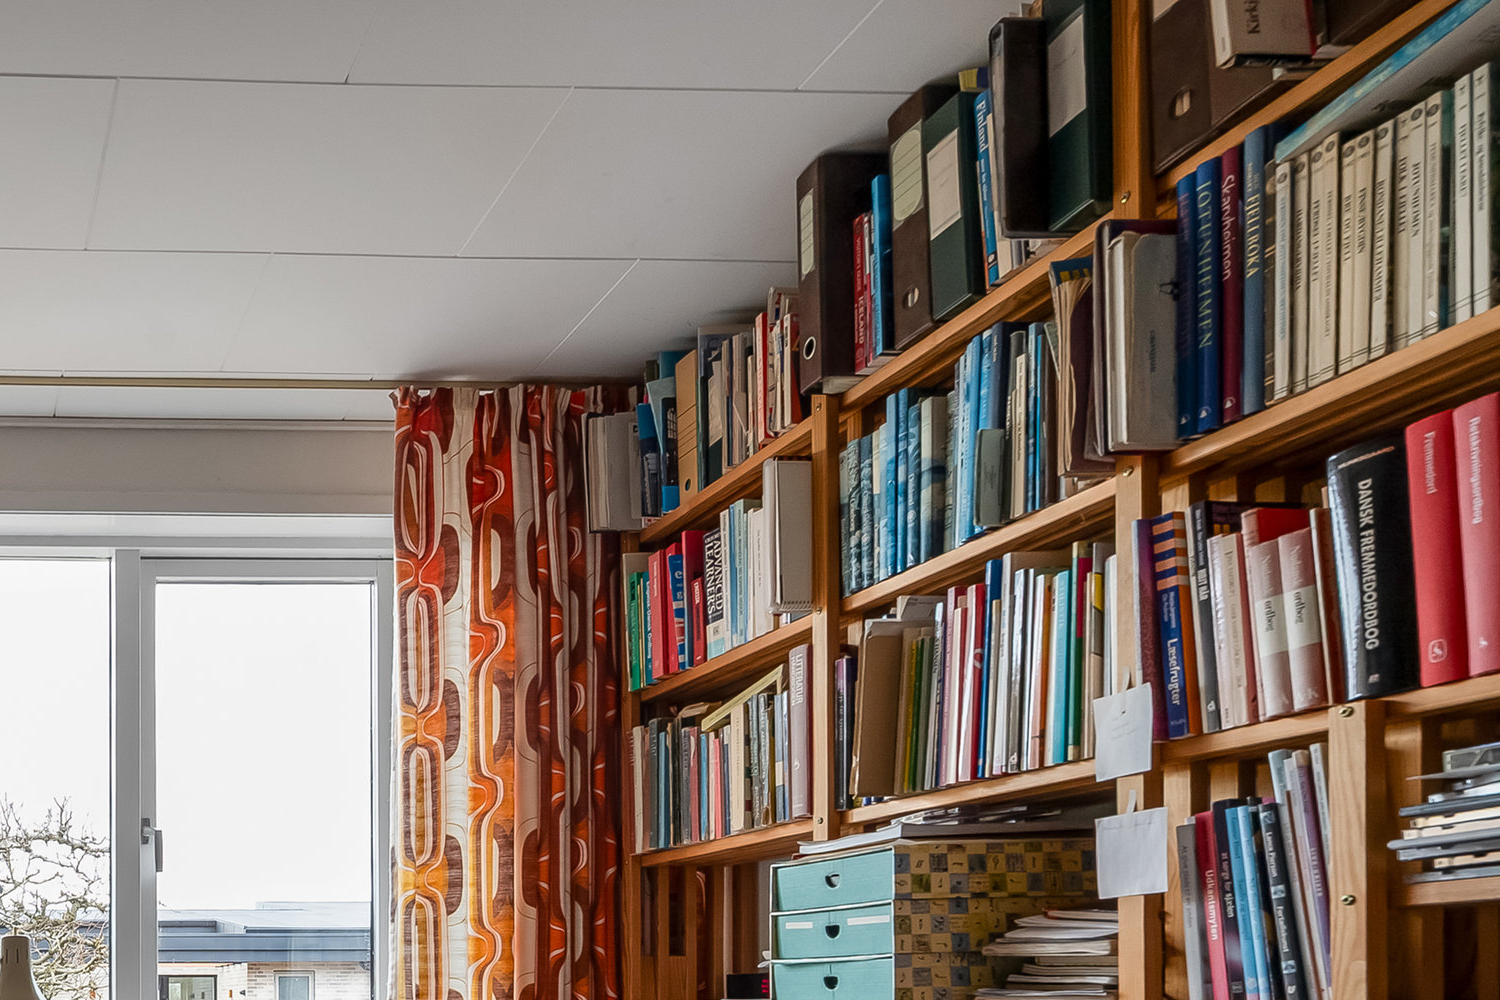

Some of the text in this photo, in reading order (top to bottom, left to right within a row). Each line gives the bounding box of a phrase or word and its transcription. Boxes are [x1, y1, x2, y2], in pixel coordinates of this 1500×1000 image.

[976, 100, 989, 153] Finland
[1196, 181, 1212, 349] JOTUNHEIMEN
[1246, 193, 1261, 279] FJELLBOKA
[1423, 430, 1439, 495] Fremmedord
[704, 543, 716, 615] LEARNER'S
[713, 540, 724, 611] ADVANCED
[1357, 477, 1380, 651] DANSK FREMMEDORDBOG
[1264, 599, 1277, 634] ordbog
[1294, 591, 1307, 626] ordbog
[794, 652, 805, 706] LITTERATUR
[1166, 637, 1181, 707] Læsefrugter
[1204, 869, 1219, 941] Udkantsmyten
